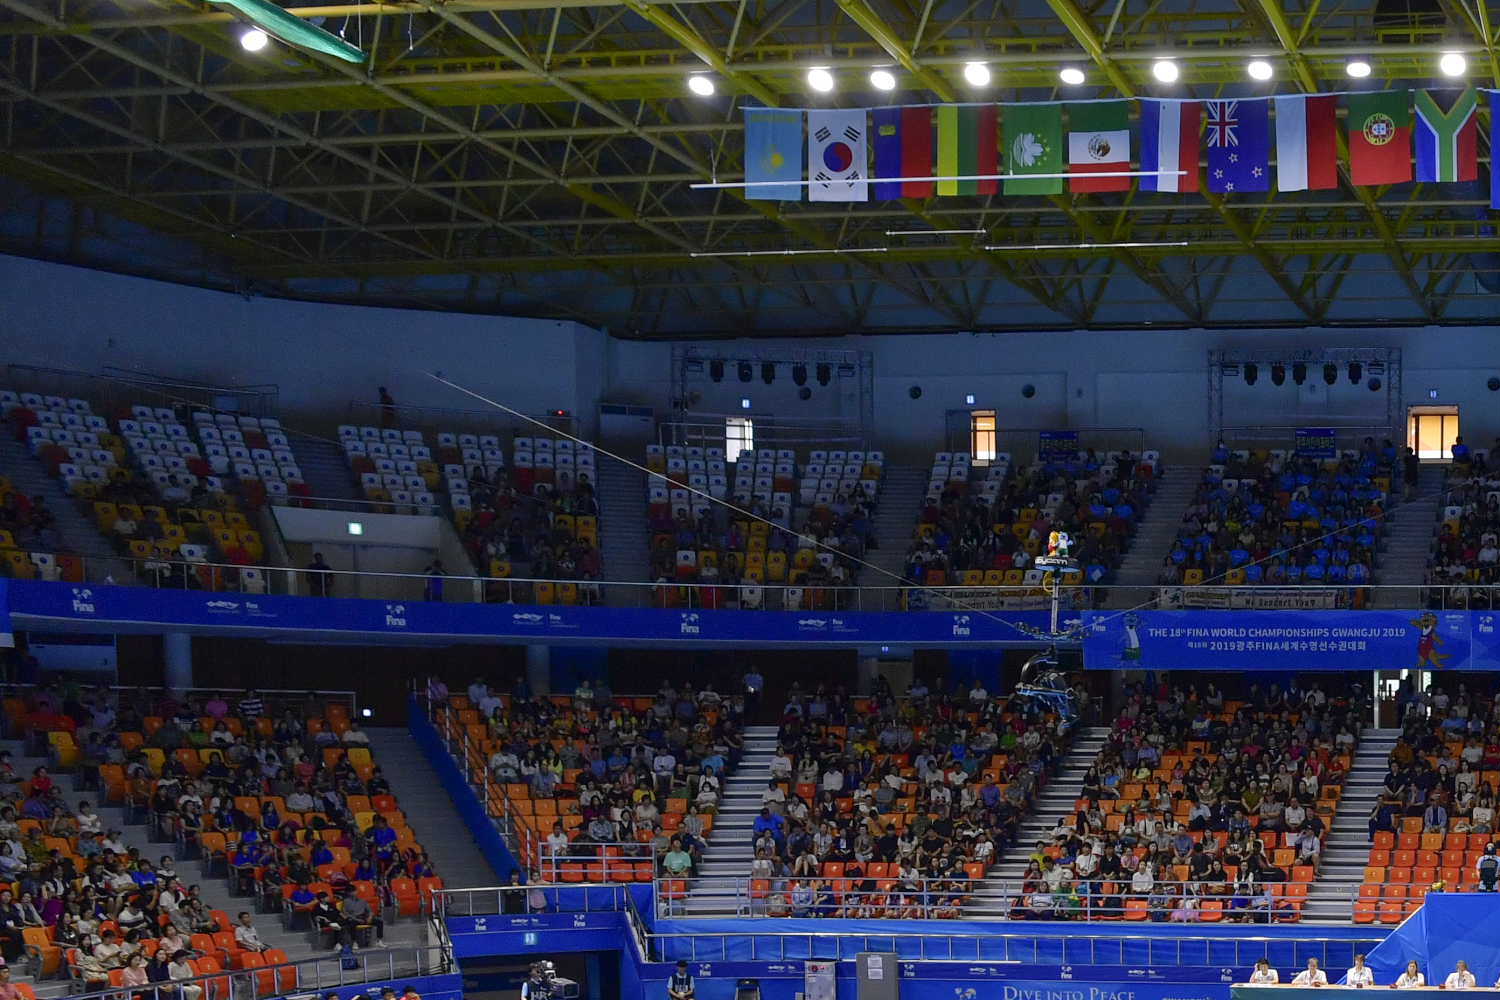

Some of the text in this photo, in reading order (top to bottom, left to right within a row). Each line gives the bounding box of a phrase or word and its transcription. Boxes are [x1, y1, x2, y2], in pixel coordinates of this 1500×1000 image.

[1149, 628, 1168, 638] THE
[1187, 628, 1210, 638] FINA
[1210, 628, 1247, 638] WORLD
[1248, 628, 1330, 638] CHAMPIONSHIPS
[1331, 628, 1380, 638] GWANGJU
[1383, 628, 1406, 638] 2019
[1003, 986, 1041, 1000] DIVE
